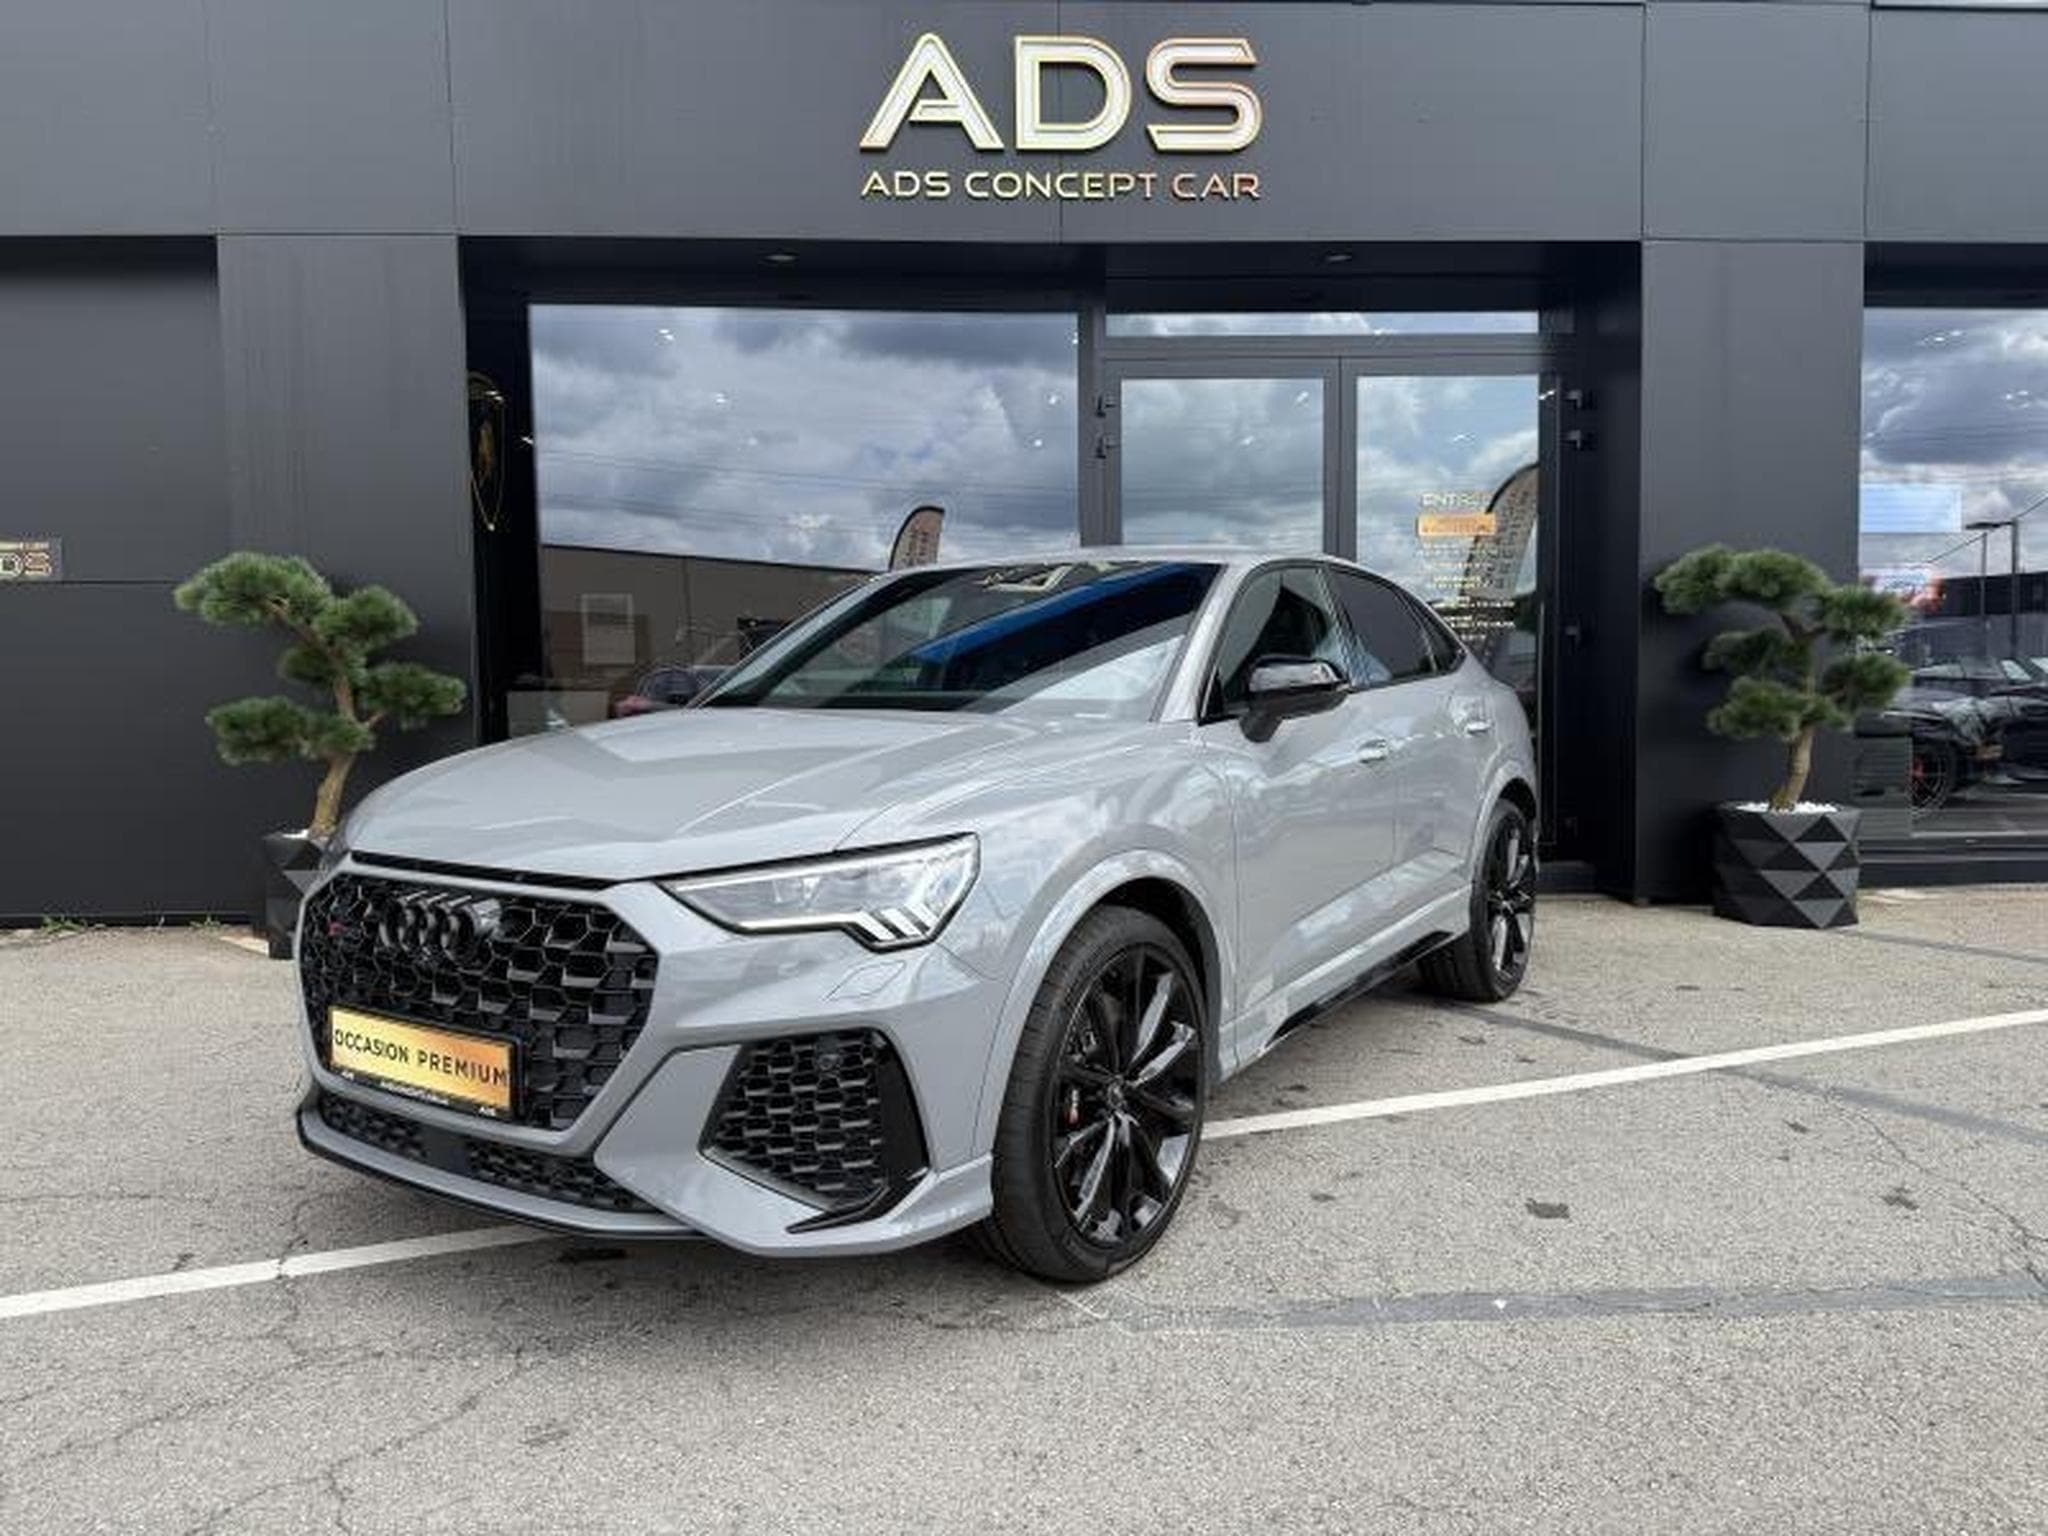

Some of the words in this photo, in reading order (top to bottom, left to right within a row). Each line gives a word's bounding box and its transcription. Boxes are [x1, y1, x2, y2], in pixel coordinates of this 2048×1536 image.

[860, 33, 1264, 152] ADS
[861, 171, 951, 198] ADS
[964, 171, 1157, 199] CONCEPT
[1172, 173, 1260, 200] CAR
[334, 1028, 410, 1065] OCCASION
[417, 1049, 508, 1087] PREMIUM
